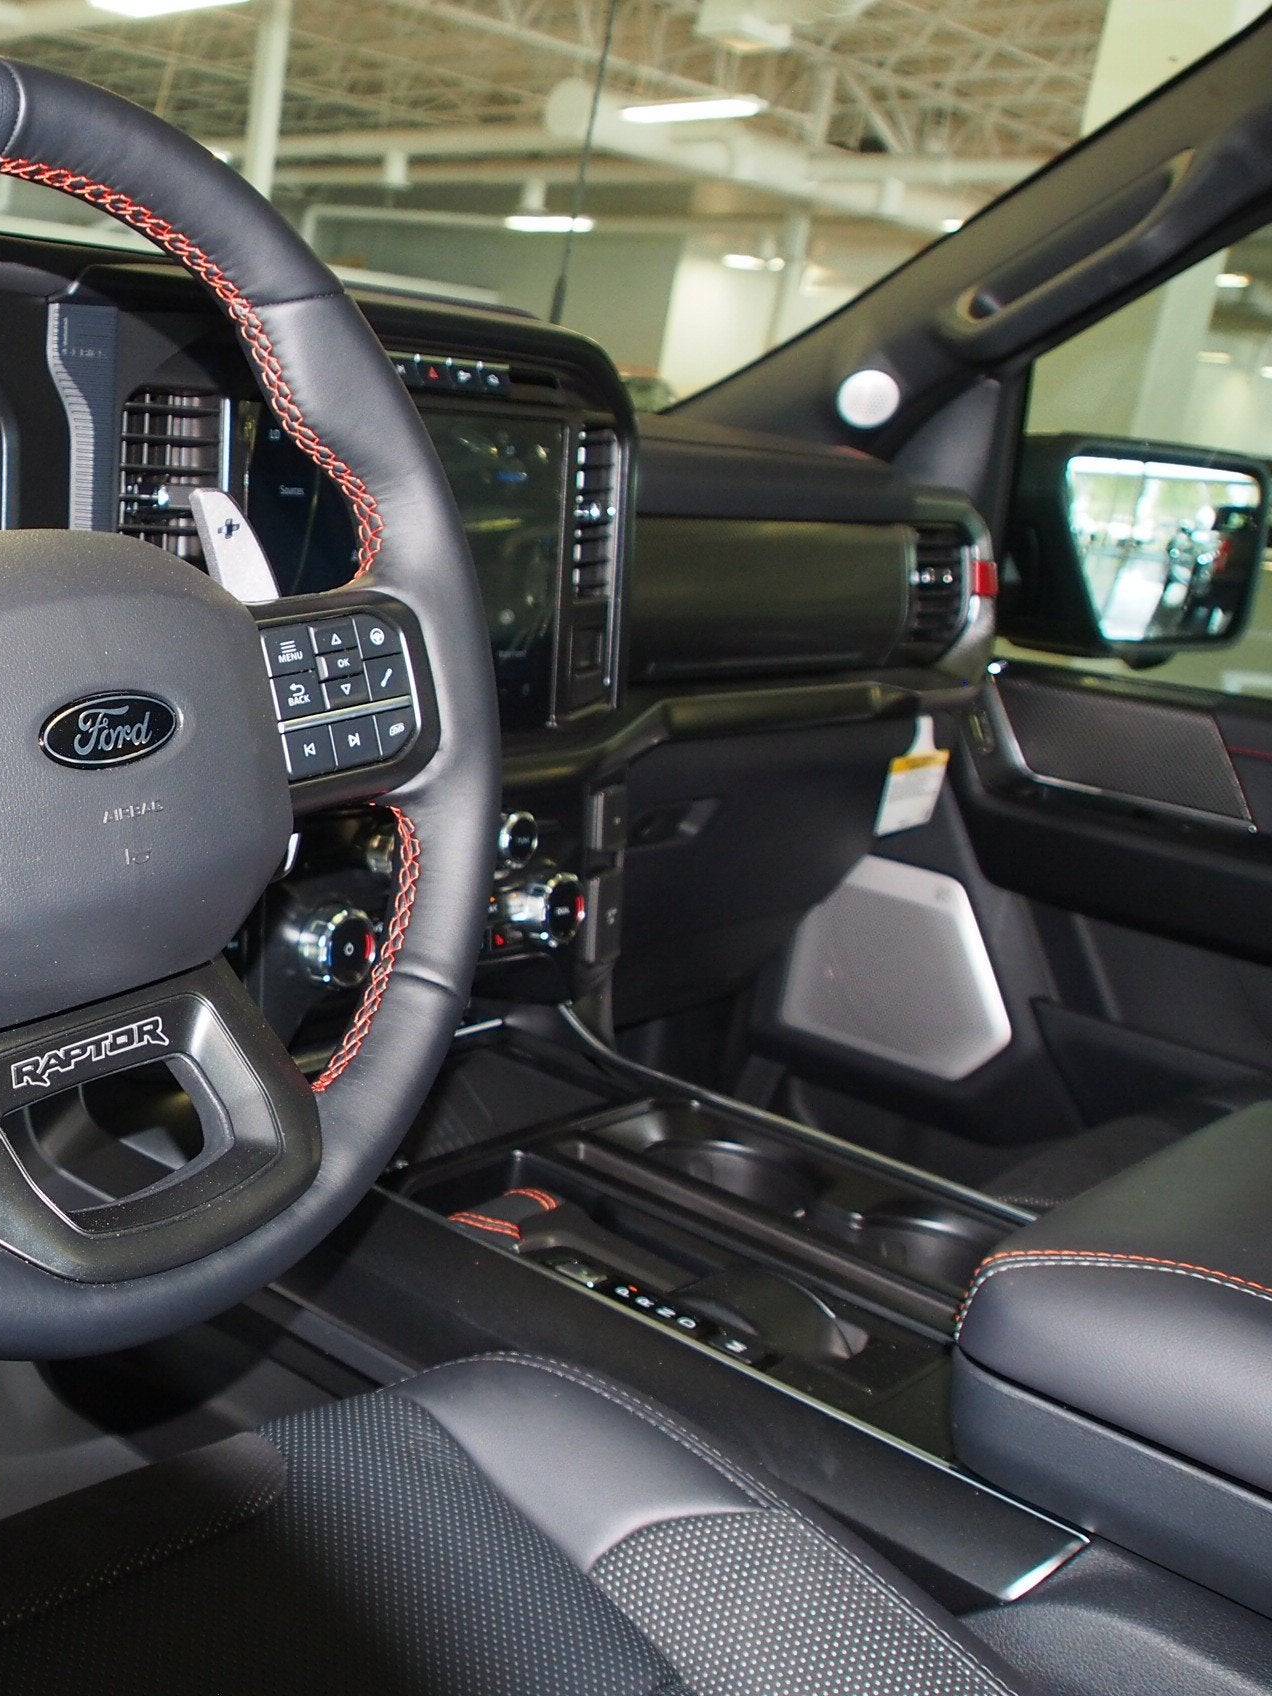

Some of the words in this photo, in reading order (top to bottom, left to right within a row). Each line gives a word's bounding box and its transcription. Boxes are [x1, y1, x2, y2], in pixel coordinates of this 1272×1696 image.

[278, 651, 303, 663] MENU
[337, 657, 351, 669] OK
[287, 693, 311, 708] BACK
[74, 705, 152, 756] Ford
[102, 800, 165, 824] AIRBAG
[11, 1016, 169, 1089] RAPTOR
